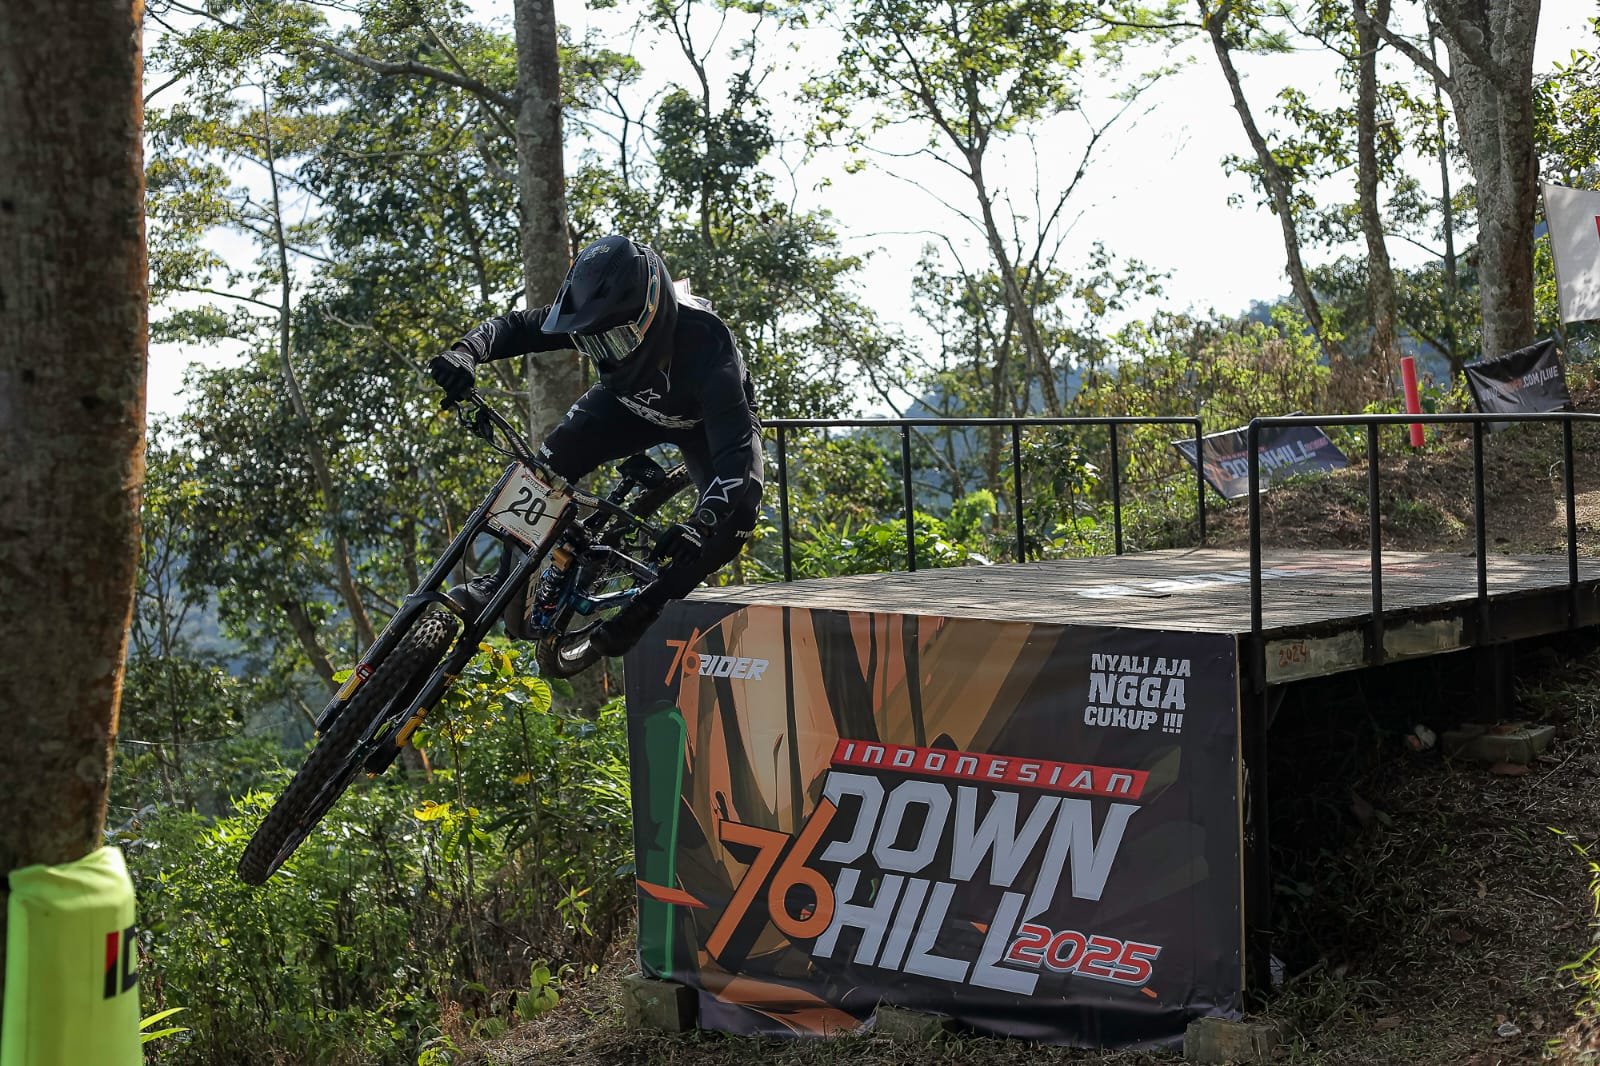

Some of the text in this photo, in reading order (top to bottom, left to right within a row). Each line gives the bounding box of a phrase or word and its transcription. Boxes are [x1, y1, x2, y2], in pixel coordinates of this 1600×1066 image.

[1220, 440, 1317, 479] DONHILL
[507, 486, 547, 526] 20
[1091, 653, 1191, 677] NYALI AJA
[1088, 672, 1186, 710] NGGA
[1084, 706, 1183, 734] CUKUP !!!
[843, 742, 1134, 795] INDONESIAN
[706, 771, 1141, 962] 76 DOWN
[812, 867, 1039, 996] HILL
[1008, 924, 1162, 985] 2025
